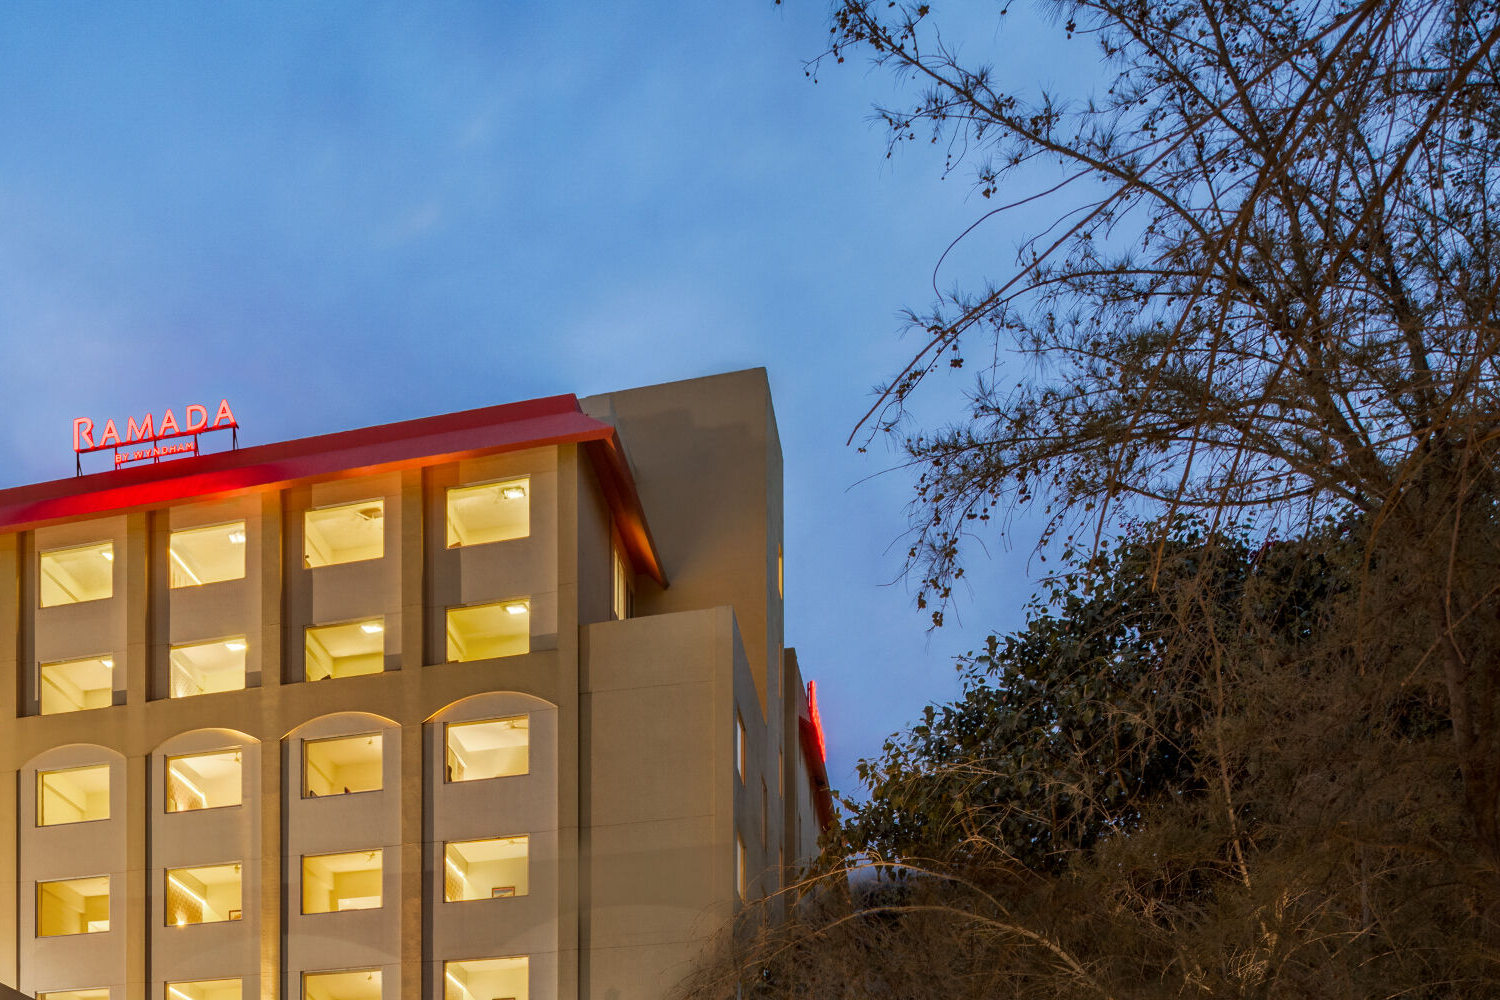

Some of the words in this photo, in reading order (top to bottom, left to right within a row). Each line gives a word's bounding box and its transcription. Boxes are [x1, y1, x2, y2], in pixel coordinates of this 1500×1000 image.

[73, 399, 236, 451] RAMADA
[115, 453, 129, 463] BY
[133, 442, 194, 459] WYNDHAM
